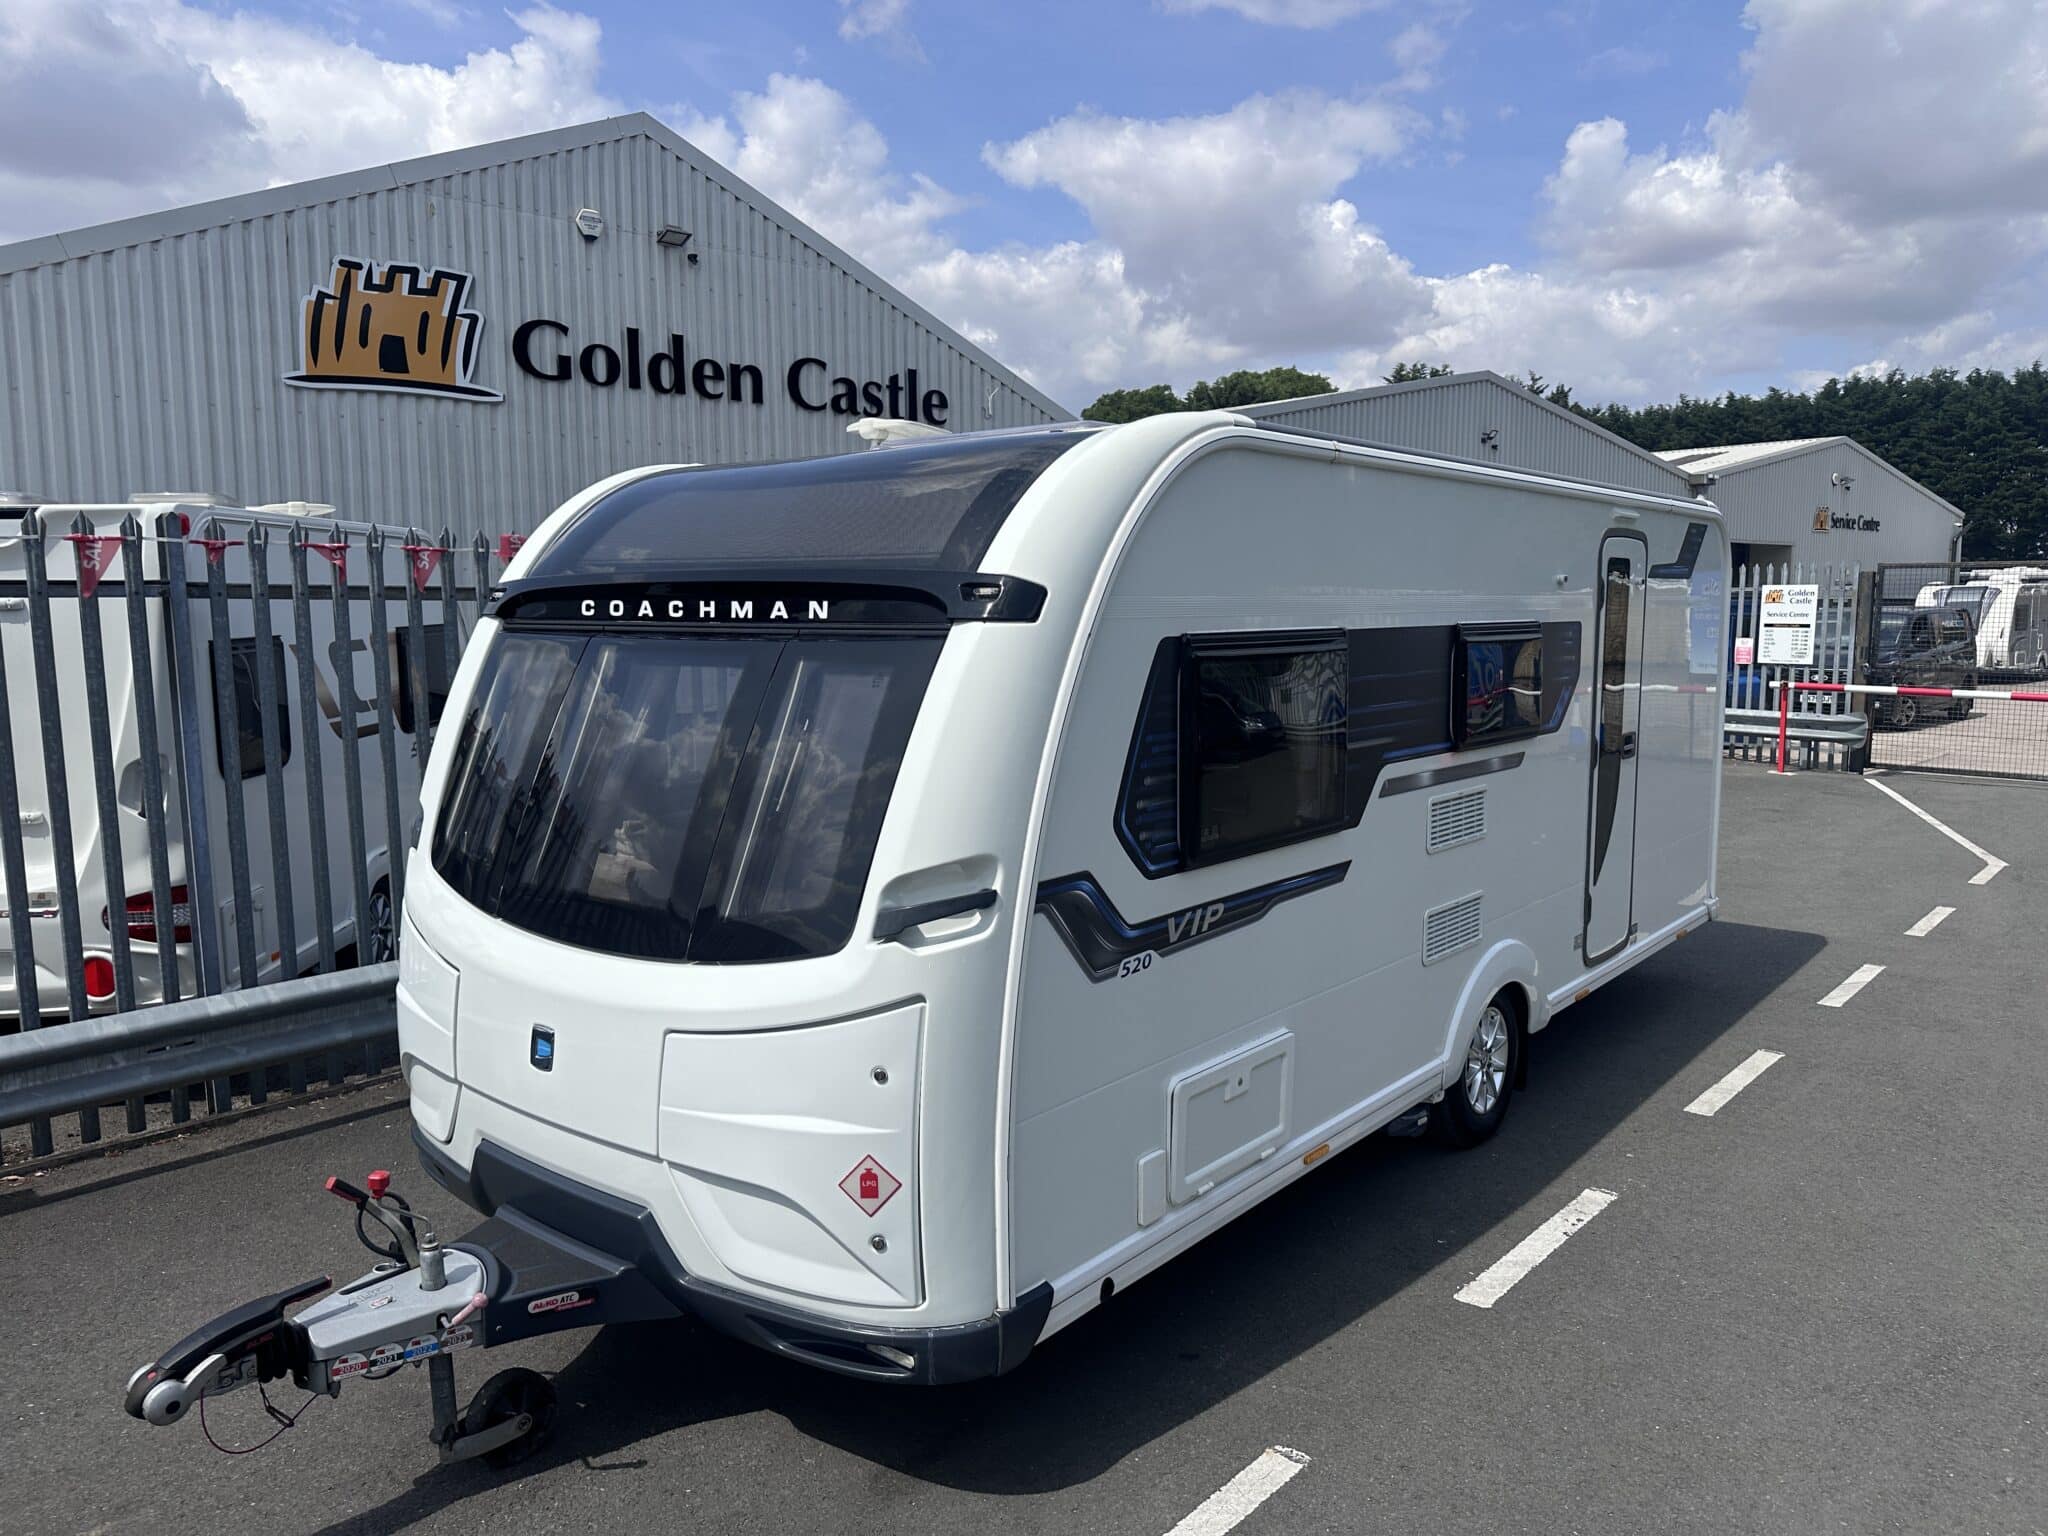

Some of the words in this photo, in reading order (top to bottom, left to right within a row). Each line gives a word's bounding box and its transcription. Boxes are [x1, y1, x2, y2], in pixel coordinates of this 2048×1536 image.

[512, 319, 764, 404] Golden
[787, 357, 949, 425] Castle
[1831, 512, 1856, 530] Service
[1857, 515, 1880, 532] Centre
[84, 540, 102, 570] SAL
[1788, 589, 1815, 597] Golden
[581, 600, 828, 619] COACHMAN
[1167, 902, 1225, 943] VIP
[1120, 953, 1152, 978] 520
[413, 1344, 434, 1357] 2022
[340, 1363, 362, 1375] 2020
[376, 1354, 398, 1367] 2021
